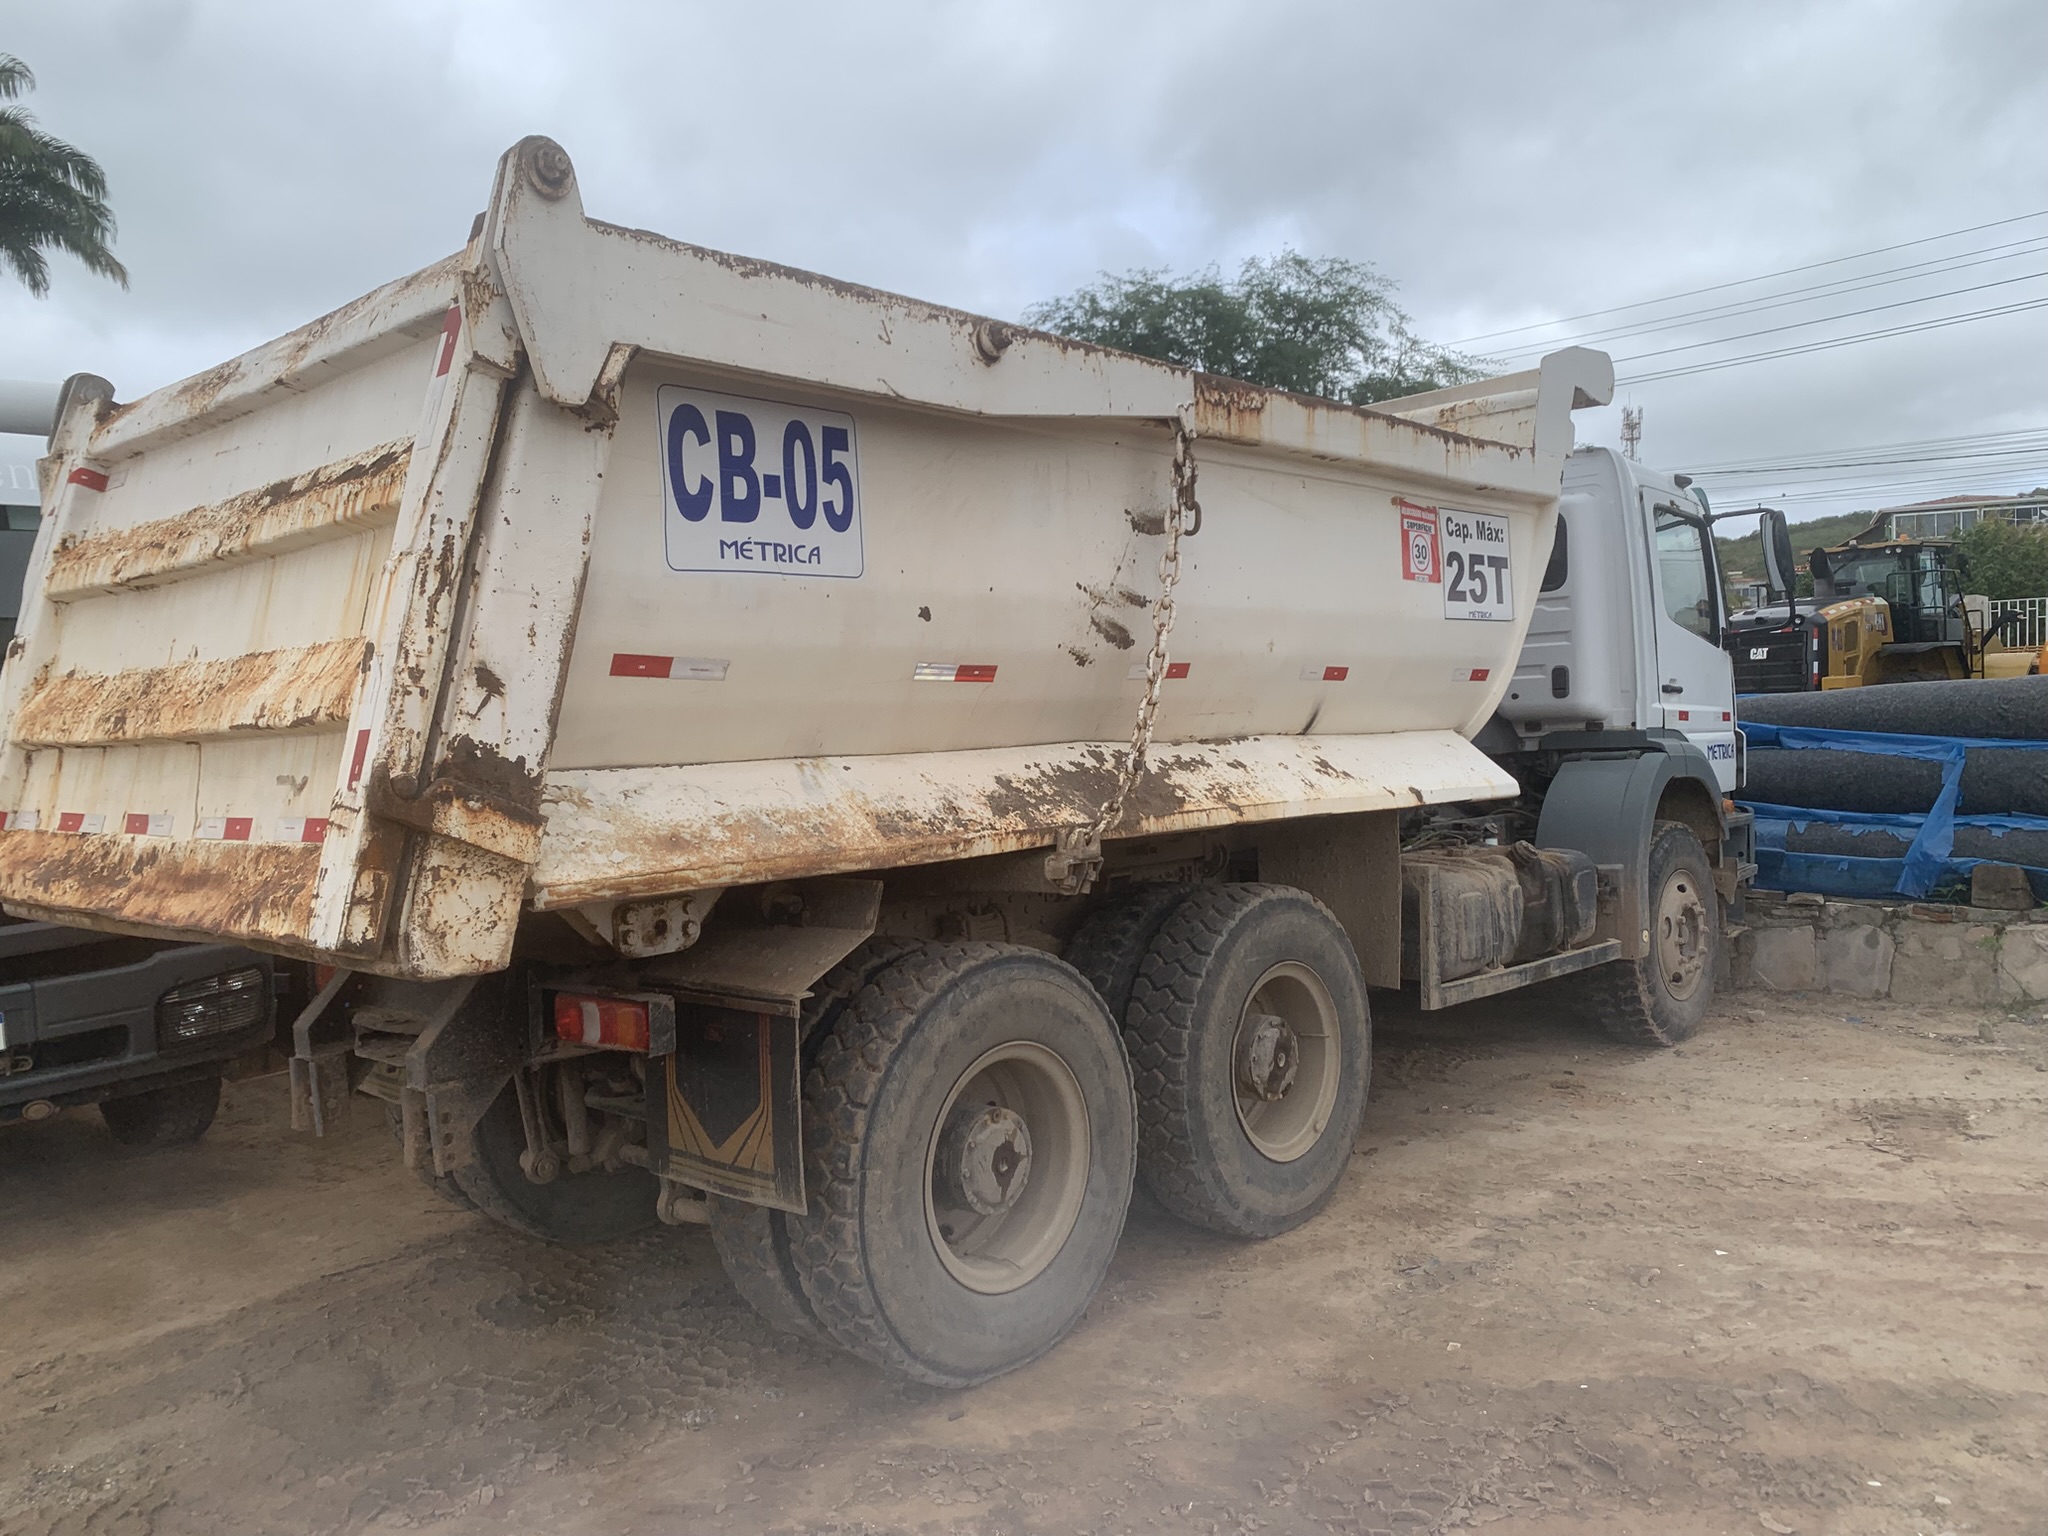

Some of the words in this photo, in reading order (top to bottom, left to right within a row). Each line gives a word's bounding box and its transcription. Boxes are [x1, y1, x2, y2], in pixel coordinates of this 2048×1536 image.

[668, 403, 854, 533] CB-05
[1445, 516, 1473, 544] Cap.
[1476, 520, 1504, 543] Máx:
[719, 537, 821, 565] MÉTRICA
[1414, 543, 1428, 560] 30
[1446, 550, 1509, 605] 25T
[1750, 647, 1769, 660] CAT
